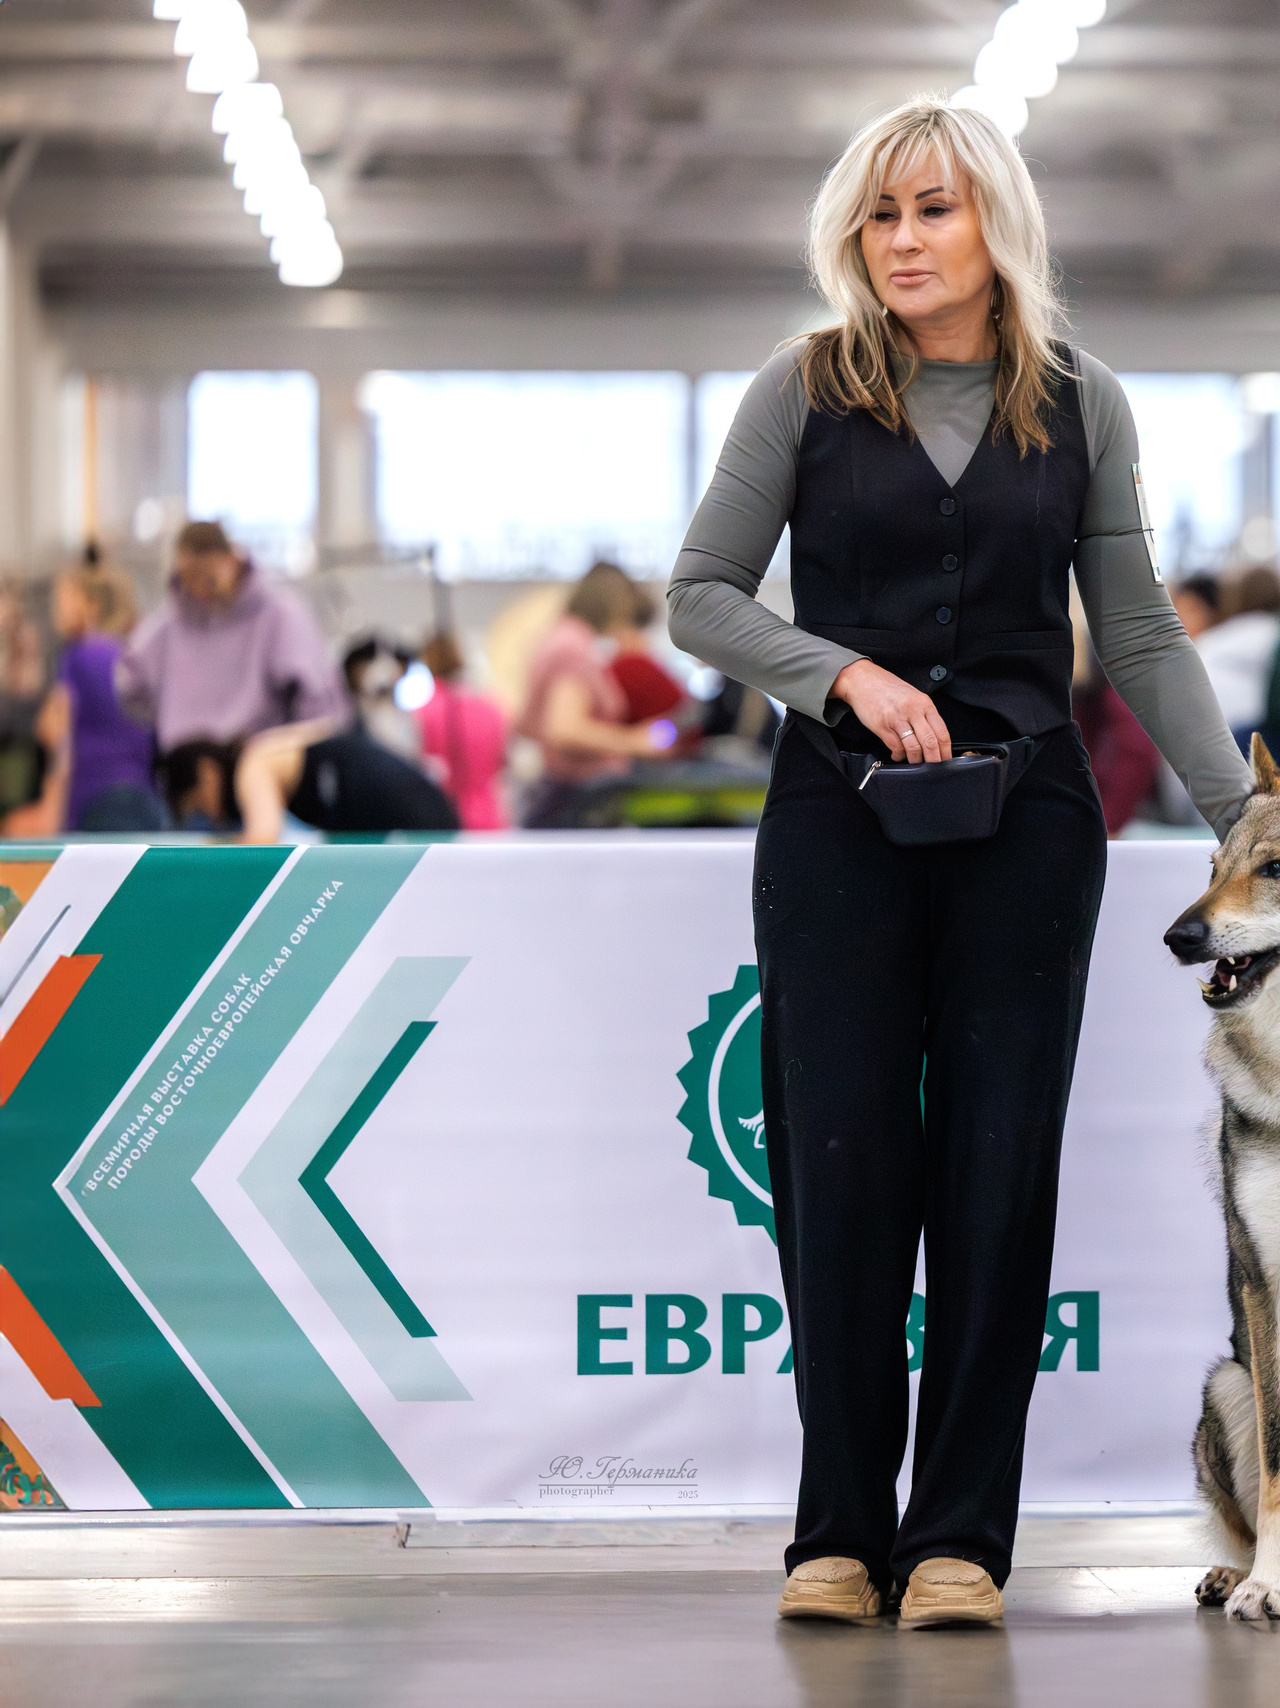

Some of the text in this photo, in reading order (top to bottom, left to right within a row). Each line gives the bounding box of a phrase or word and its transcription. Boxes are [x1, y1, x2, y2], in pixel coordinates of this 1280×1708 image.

[107, 880, 344, 1190] ПОРОДЫ ВОСТОЧНОЕВРОПЕЙСКАЯ ОВЧАРКА
[151, 1026, 214, 1104] ВЫСТАВКА
[211, 973, 252, 1024] СОБАК
[577, 1290, 1101, 1376] ЕВРЯ
